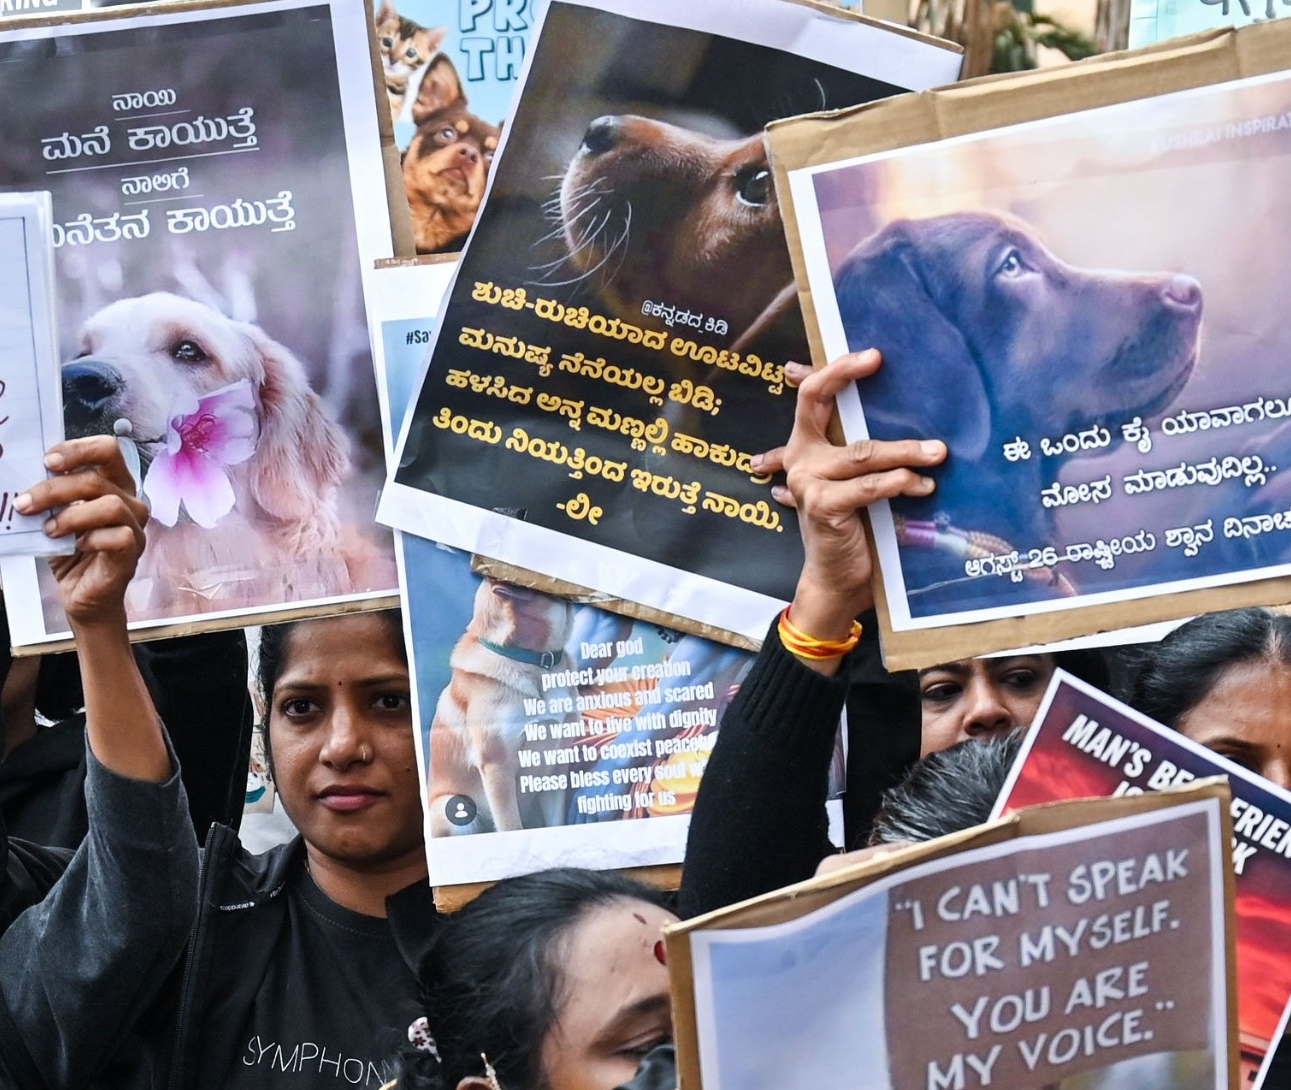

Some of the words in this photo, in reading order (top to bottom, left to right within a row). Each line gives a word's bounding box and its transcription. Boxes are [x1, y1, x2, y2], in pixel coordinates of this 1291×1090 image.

[112, 88, 177, 112] ನಾಯಿ
[41, 125, 111, 160] ಮನೆ
[127, 107, 258, 148] ಕಾಯುತ್ತೆ
[121, 166, 190, 195] ನಾಲಿಗೆ
[166, 190, 296, 233] ಕಾಯುತ್ತೆ
[459, 327, 553, 377] ಮನುಷ್ಯ
[559, 352, 665, 407] ನೆನೆಯಲ್ಲ
[446, 368, 533, 405] ಹಳಸಿದ
[536, 392, 585, 431] ಅನ್ನ
[586, 406, 669, 456] ಮಣ್ಣಲ್ಲಿ
[433, 407, 502, 445] ತಿಂದು
[630, 467, 701, 515] ಇರುತ್ತೆ
[1003, 436, 1032, 463] ಈ
[1040, 424, 1111, 457] ಒಂದು
[1122, 416, 1153, 454] ಕೈ
[1041, 475, 1112, 508] ಮೋಸ
[1028, 546, 1058, 569] 26
[1165, 519, 1214, 557] ಶ್ವಾನ
[581, 640, 613, 660] Dear
[616, 637, 644, 658] god
[542, 669, 593, 692] protect
[595, 668, 629, 686] your
[633, 660, 691, 678] creation
[523, 699, 546, 716] We
[549, 698, 573, 713] are
[576, 692, 631, 711] anxious
[635, 688, 661, 705] and
[664, 682, 714, 702] scared
[524, 723, 547, 741] We
[550, 719, 586, 739] want
[588, 719, 603, 735] to
[607, 716, 632, 733] live
[635, 712, 666, 731] with
[669, 707, 717, 730] dignity
[518, 750, 540, 768] We
[544, 746, 580, 766] want
[582, 745, 597, 761] to
[600, 741, 653, 760] coexist
[1061, 714, 1152, 779] MAN'S
[1147, 759, 1197, 790] BE
[520, 774, 567, 793] Please
[570, 769, 609, 788] bless
[613, 765, 652, 786] every
[577, 794, 632, 815] fighting
[635, 791, 654, 809] for
[659, 791, 676, 806] us
[937, 873, 1051, 922] CAN'T
[1068, 849, 1189, 905] SPEAK
[919, 935, 1005, 982] FOR
[1020, 899, 1180, 968] MYSELF.
[950, 986, 1050, 1040] YOU
[1065, 962, 1149, 1015] ARE
